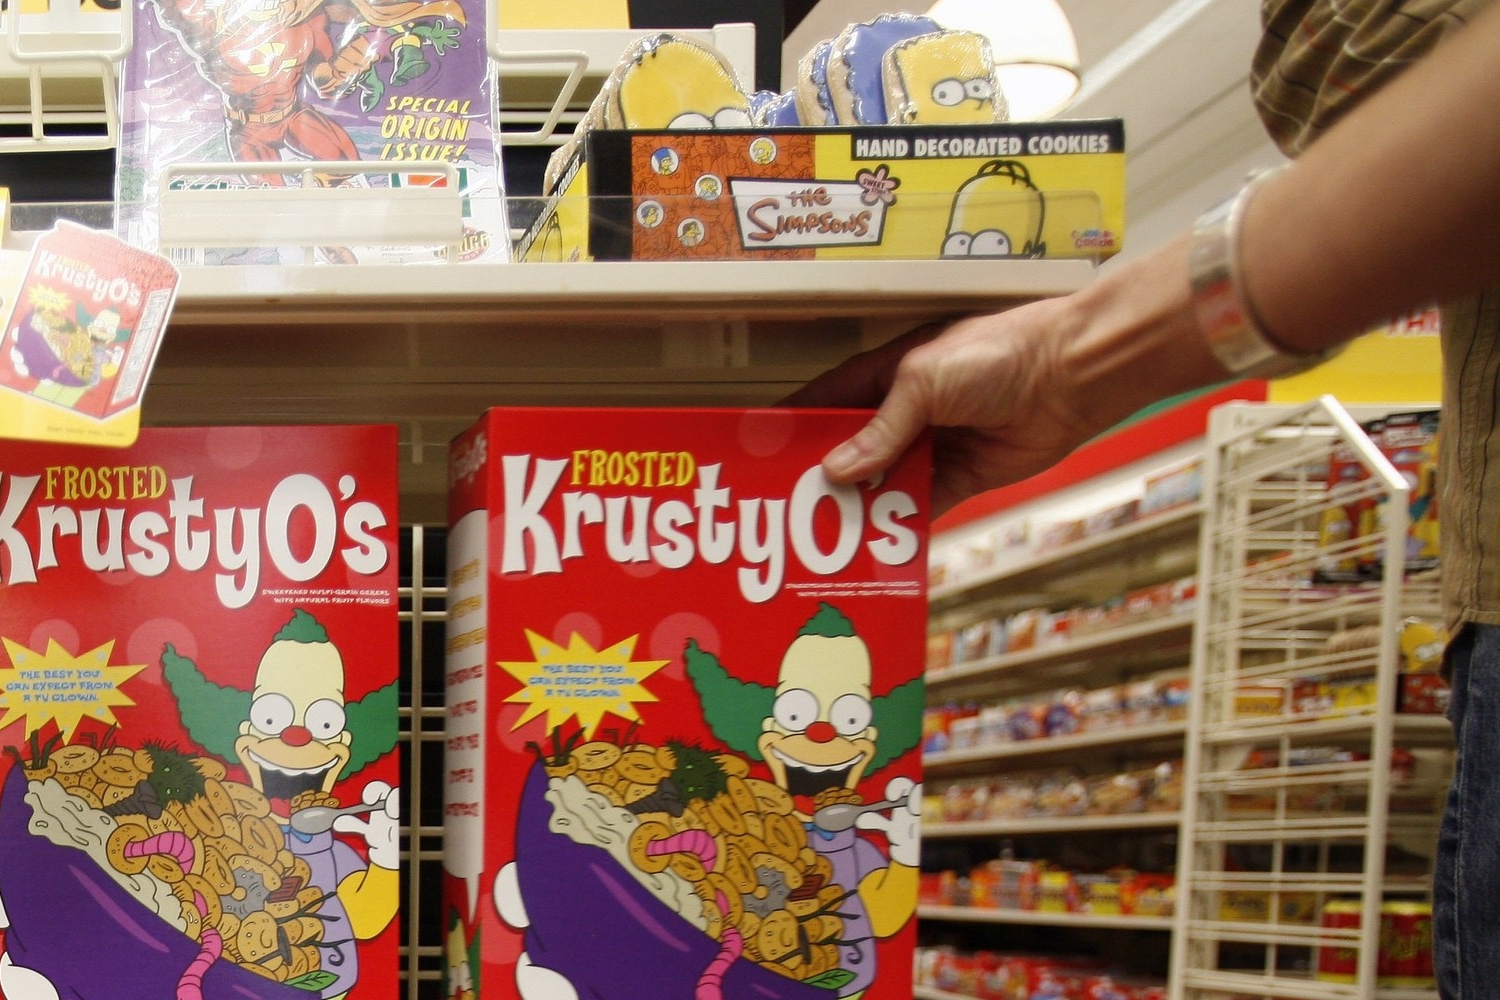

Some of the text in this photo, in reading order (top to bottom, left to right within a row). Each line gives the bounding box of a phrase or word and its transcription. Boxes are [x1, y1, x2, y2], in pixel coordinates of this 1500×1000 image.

[385, 96, 472, 115] SPECIAL
[380, 115, 469, 141] ORIGIN
[379, 140, 467, 162] ISSUE!
[856, 135, 1109, 158] HAND DECORATED COOKIES
[35, 251, 143, 307] KrustyO's
[571, 450, 696, 487] FROSTED
[45, 465, 167, 500] FROSTED
[19, 670, 100, 679] THE BEST YOU
[6, 682, 114, 691] CAN EXPECT FROM
